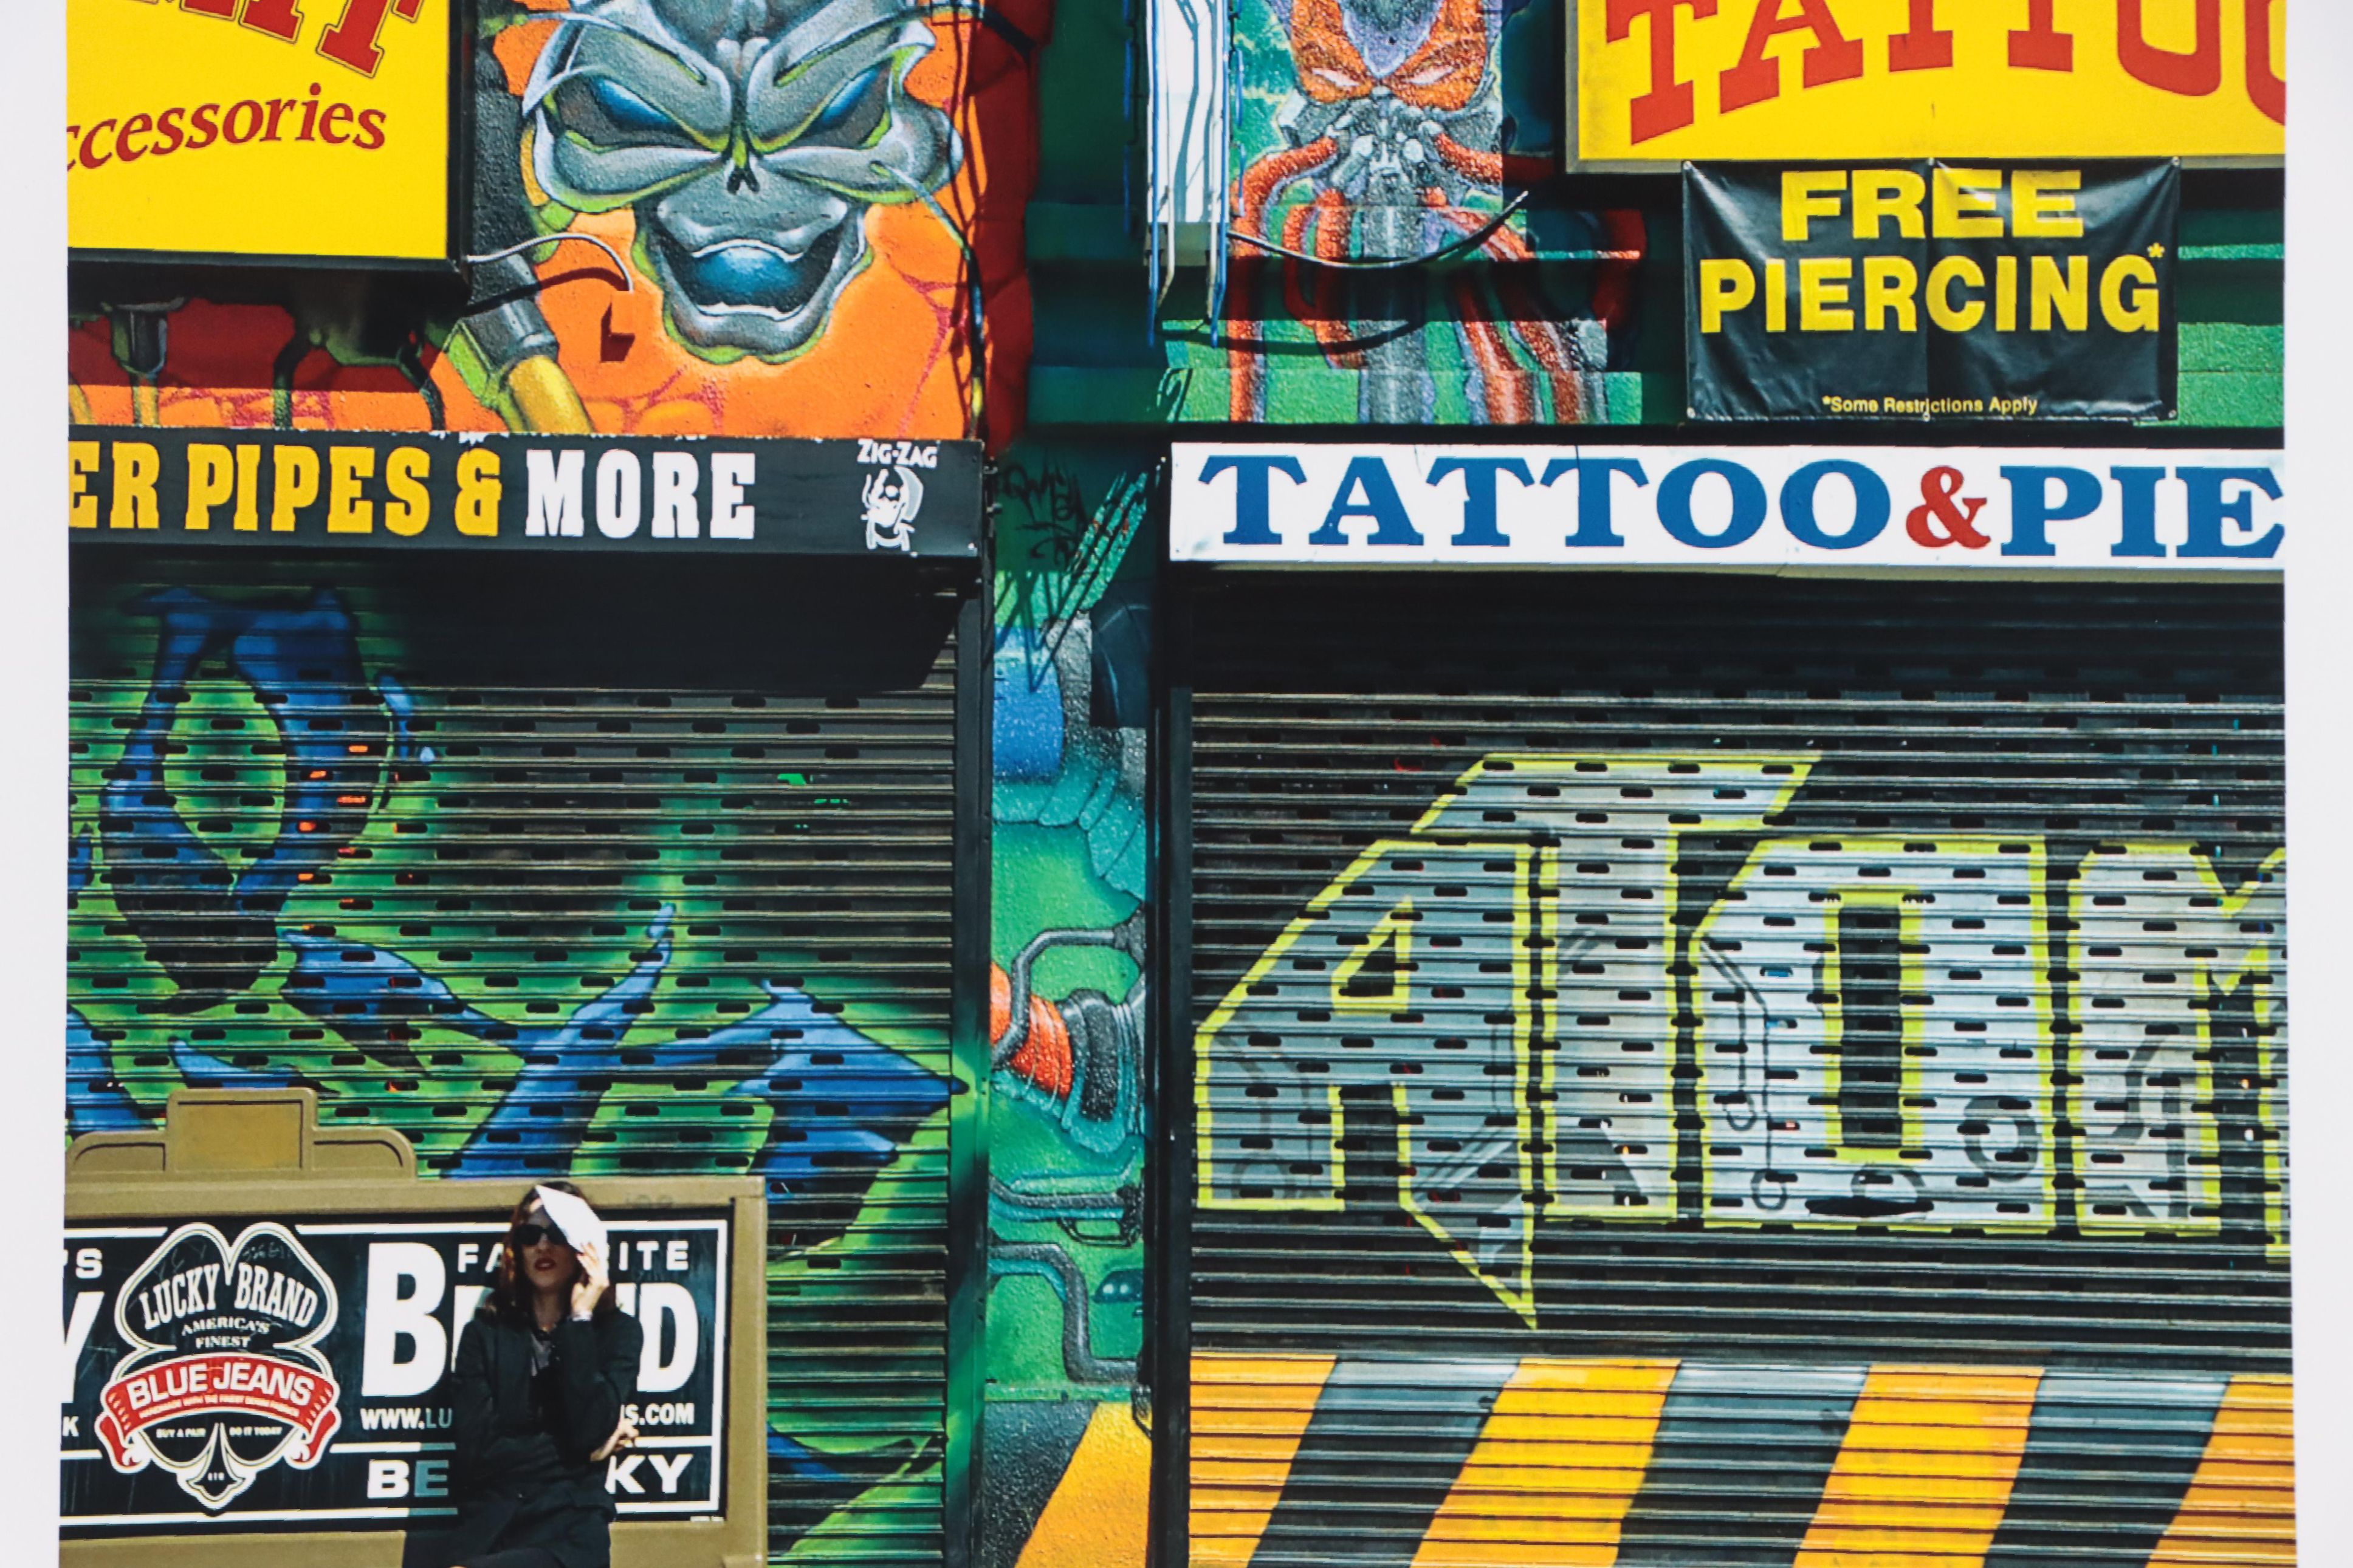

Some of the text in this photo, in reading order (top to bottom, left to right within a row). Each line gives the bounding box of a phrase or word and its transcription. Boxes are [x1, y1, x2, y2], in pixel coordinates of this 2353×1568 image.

[1781, 168, 2084, 241] FREE
[1884, 397, 1984, 414] Restrictions
[1988, 396, 2038, 416] Apply
[857, 437, 938, 468] ZIG-ZAG
[185, 443, 431, 536] PIPES
[454, 448, 502, 537] &
[525, 449, 755, 539] MORE
[1198, 454, 1891, 550] TATTOO
[1906, 465, 1991, 549] &
[2000, 465, 2285, 559] PIE
[139, 1264, 221, 1331] LUCKY
[234, 1262, 318, 1327] BRAND
[182, 1316, 270, 1337] AMERICA'S
[196, 1336, 251, 1349] FINEST
[126, 1363, 208, 1411] BLUE
[213, 1361, 315, 1406] JEANS
[367, 1459, 449, 1499] BE
